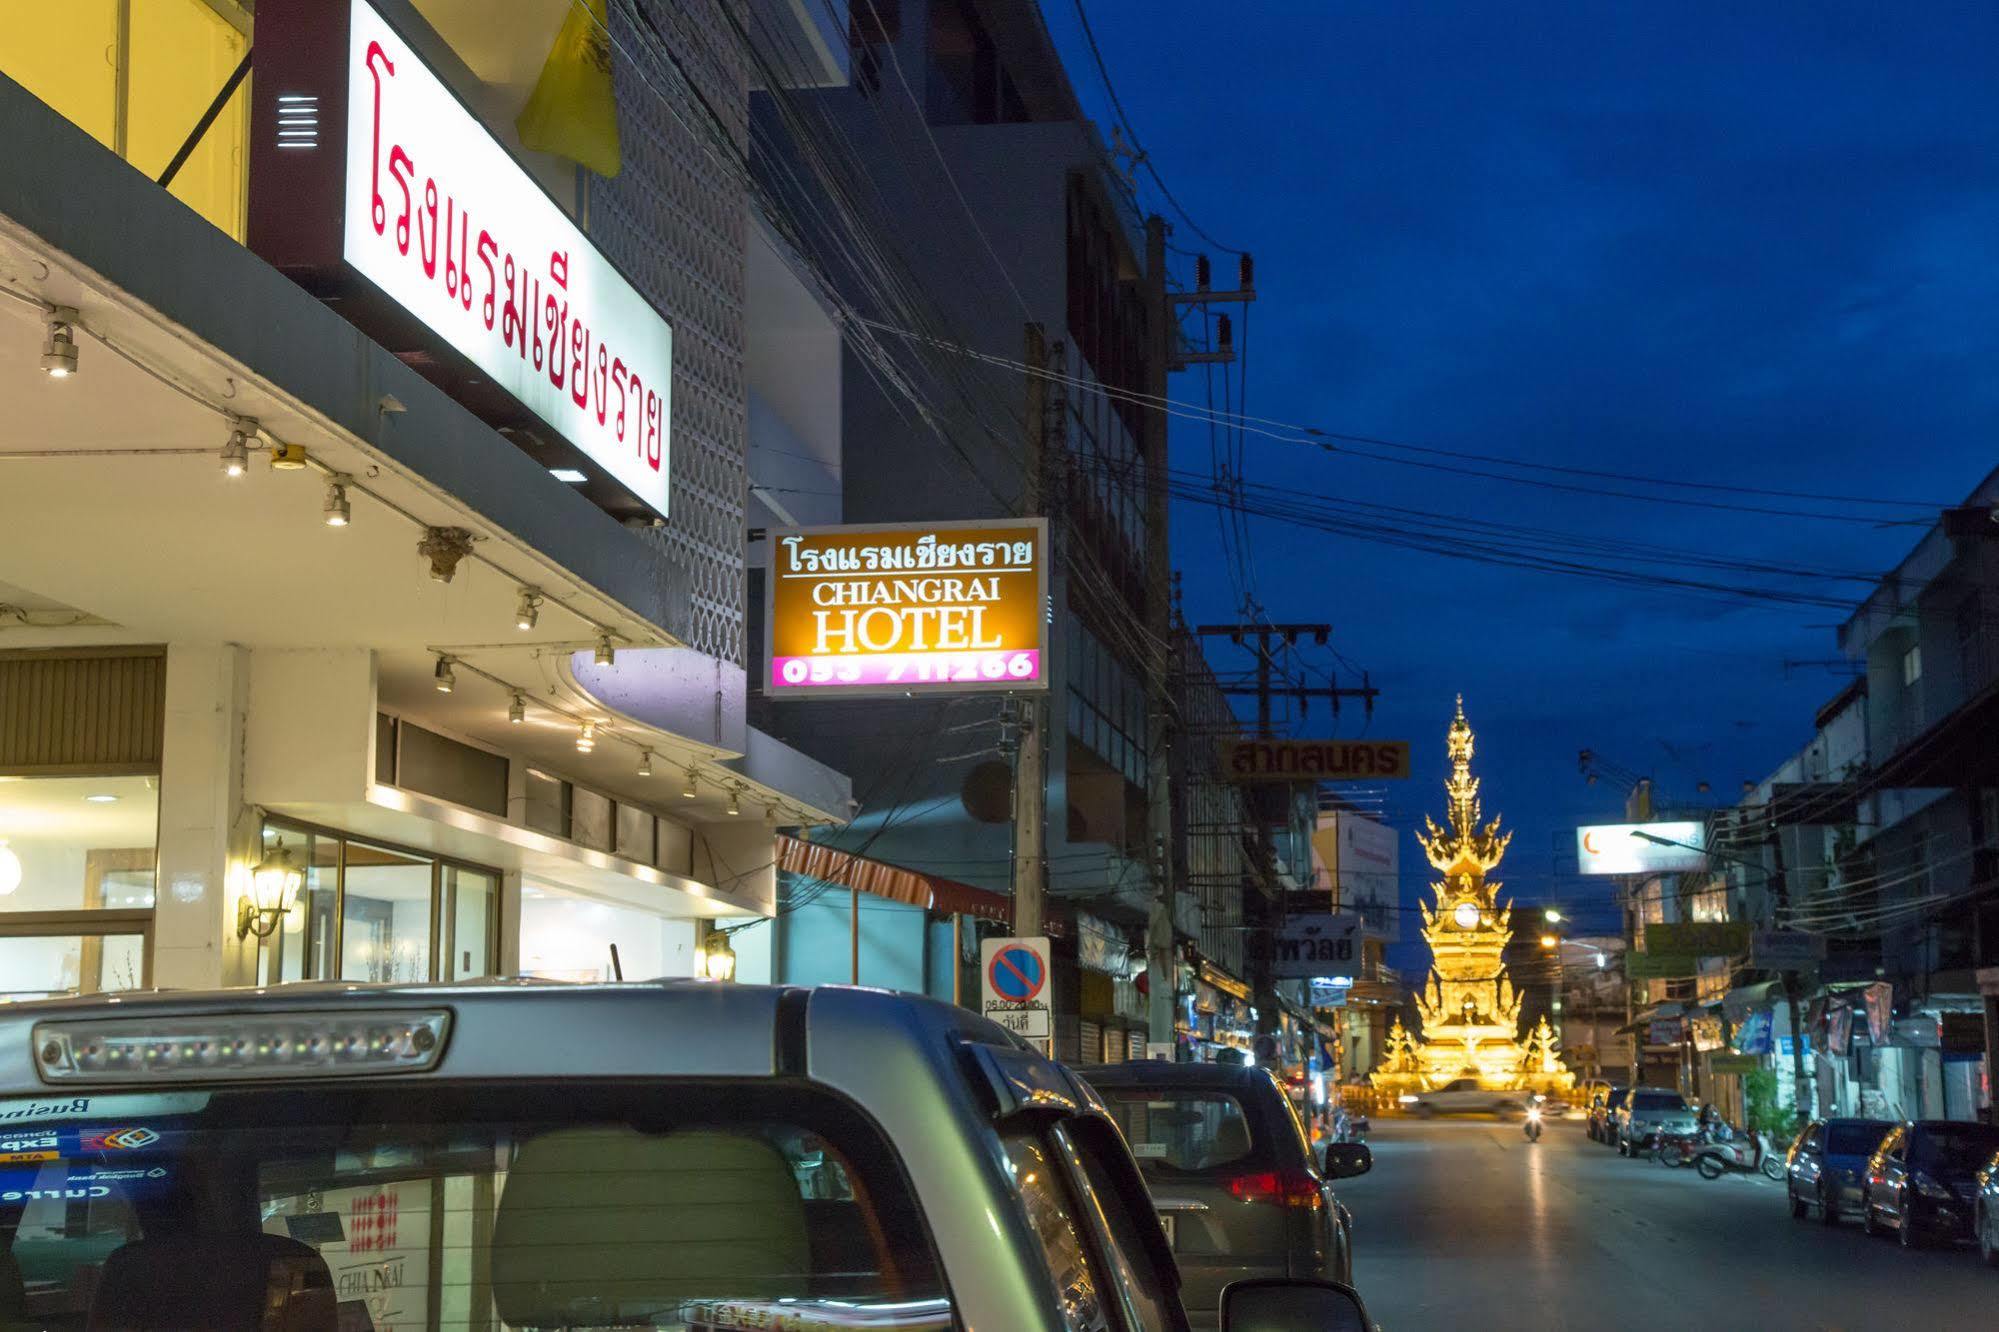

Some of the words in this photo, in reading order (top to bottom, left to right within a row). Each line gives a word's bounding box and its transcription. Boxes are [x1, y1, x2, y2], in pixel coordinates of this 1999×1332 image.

[366, 40, 663, 472] โรงแรมเชียงราย
[781, 534, 1033, 572] โรงแรมเชียงราย
[812, 577, 1001, 606] CHIANGRAI
[812, 606, 1002, 653] HOTEL
